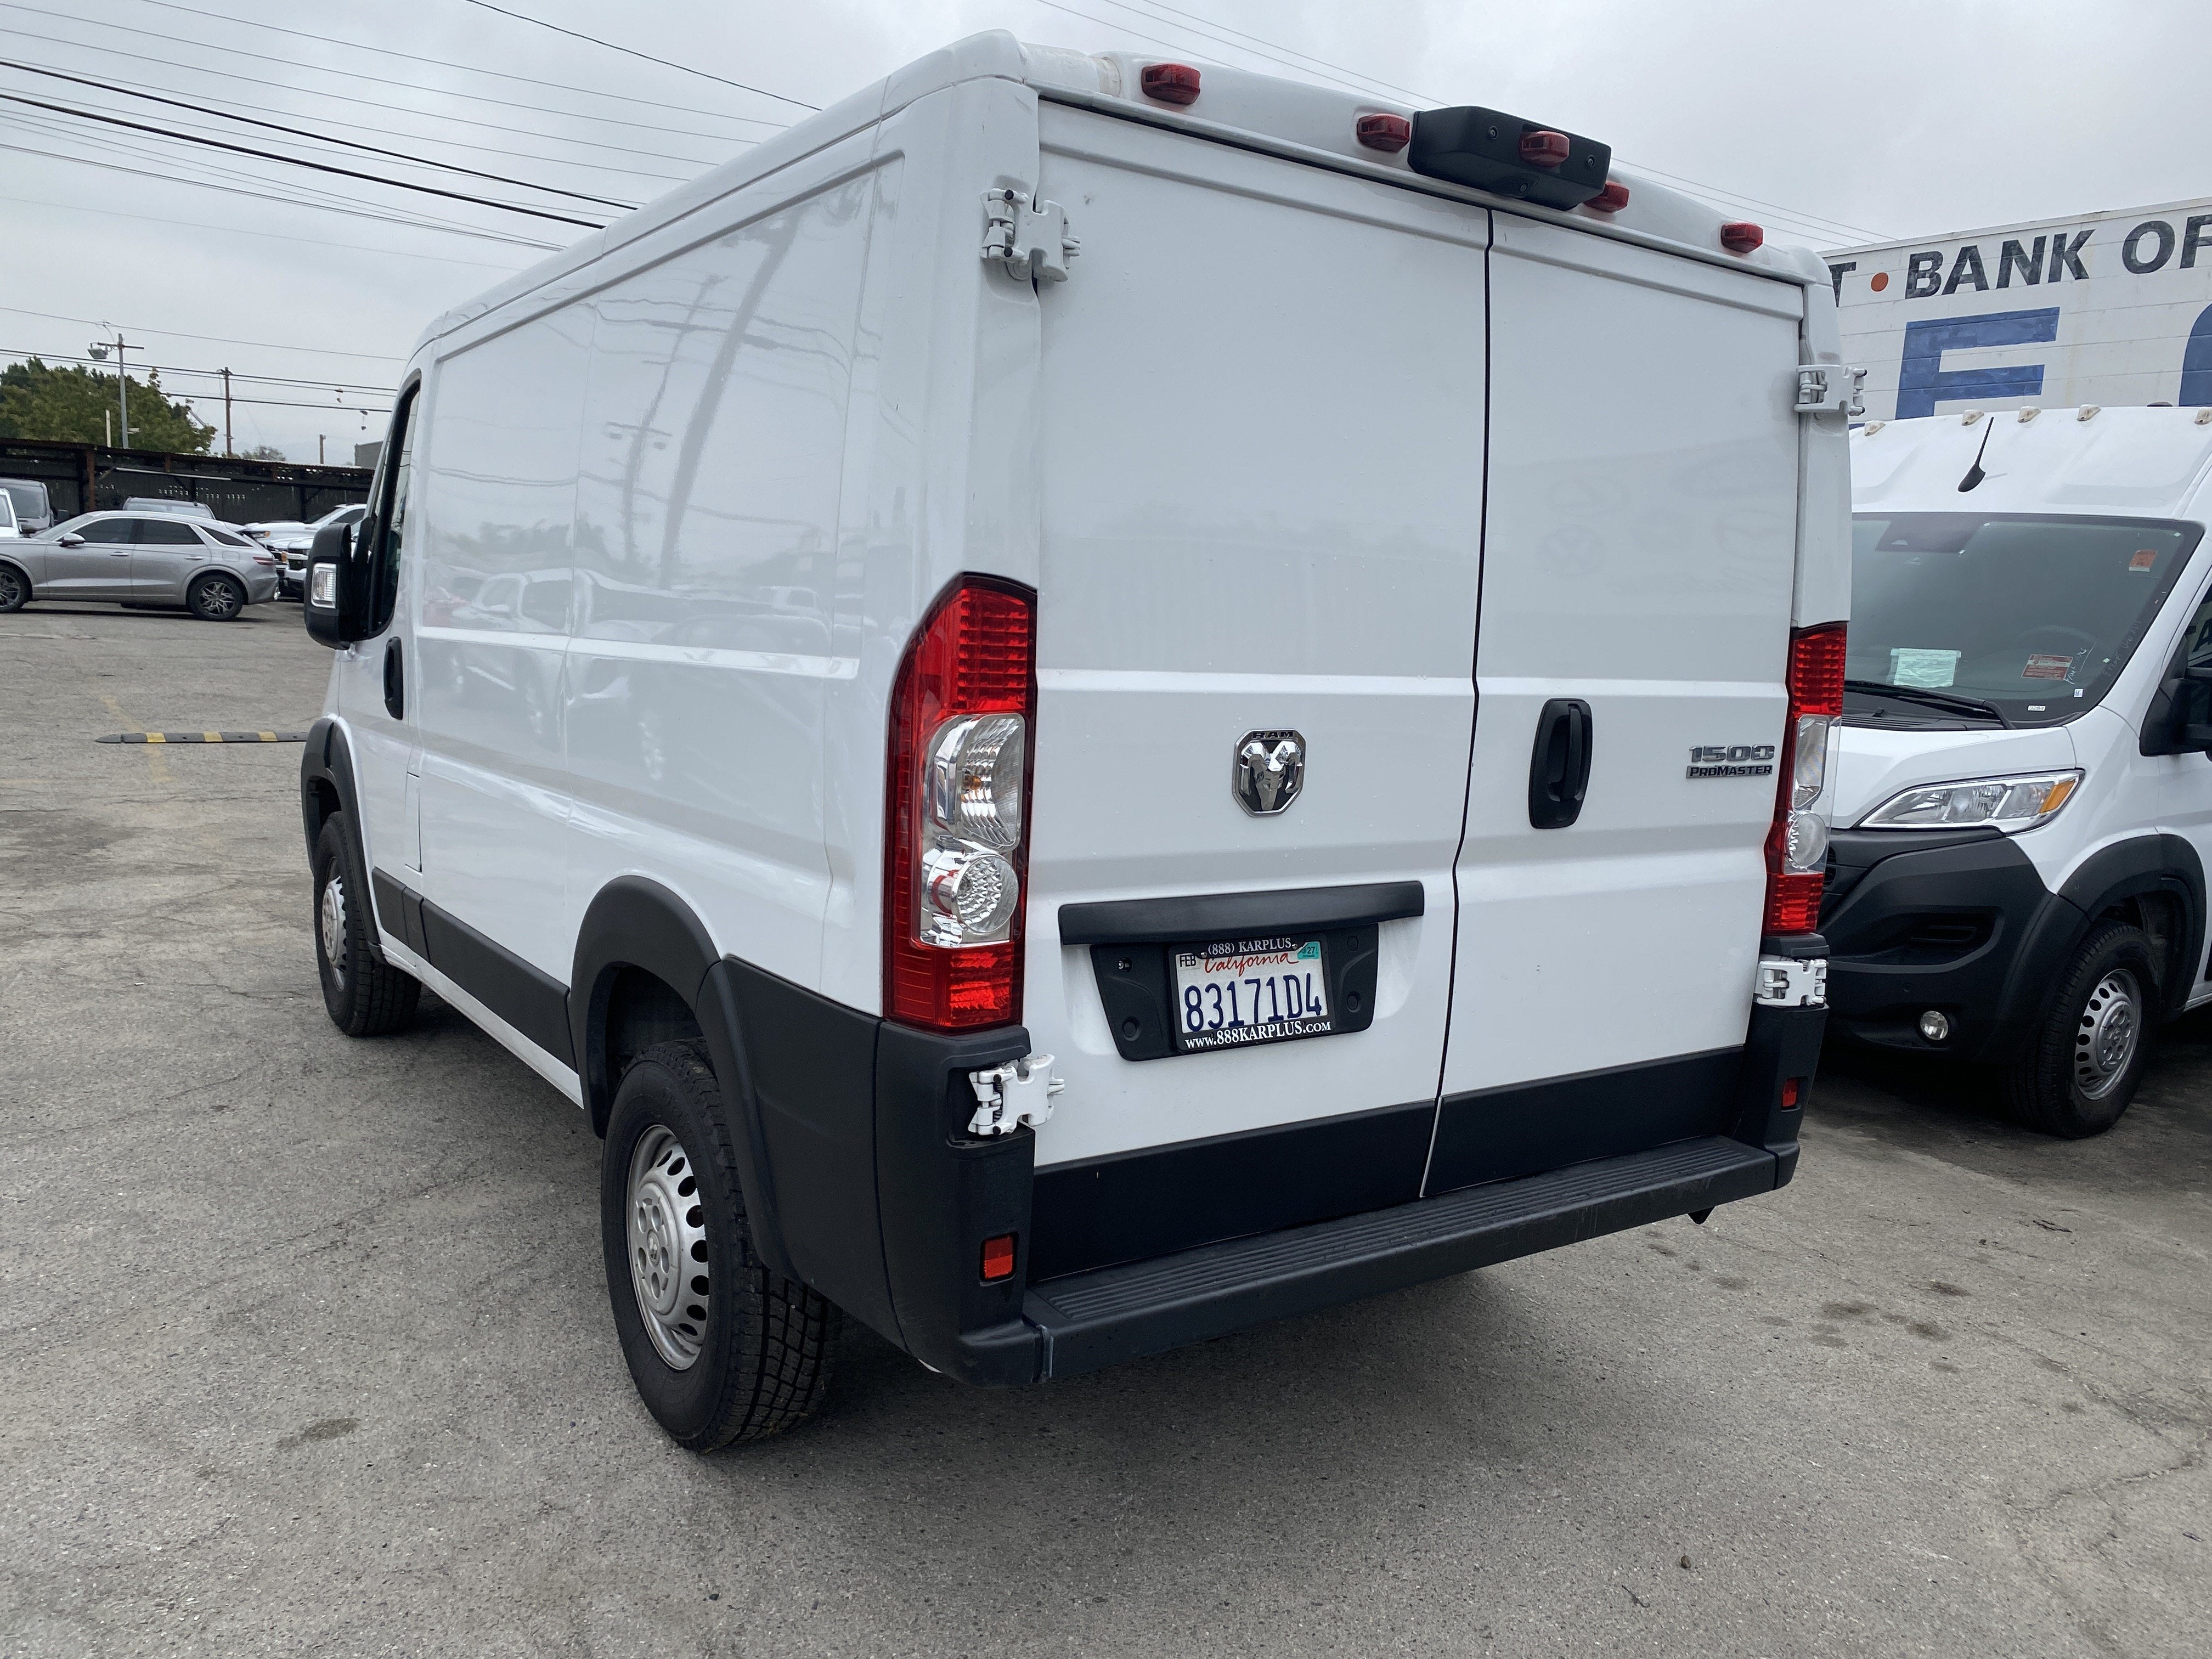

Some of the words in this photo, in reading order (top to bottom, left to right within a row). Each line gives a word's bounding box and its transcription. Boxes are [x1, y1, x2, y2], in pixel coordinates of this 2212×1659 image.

[1905, 228, 2096, 299] BANK
[1689, 744, 1775, 763] 1500
[1208, 943, 1235, 955] (888)
[1238, 937, 1291, 952] KARPLUS
[1179, 954, 1197, 967] FEB
[1184, 972, 1322, 1032] 83171D4
